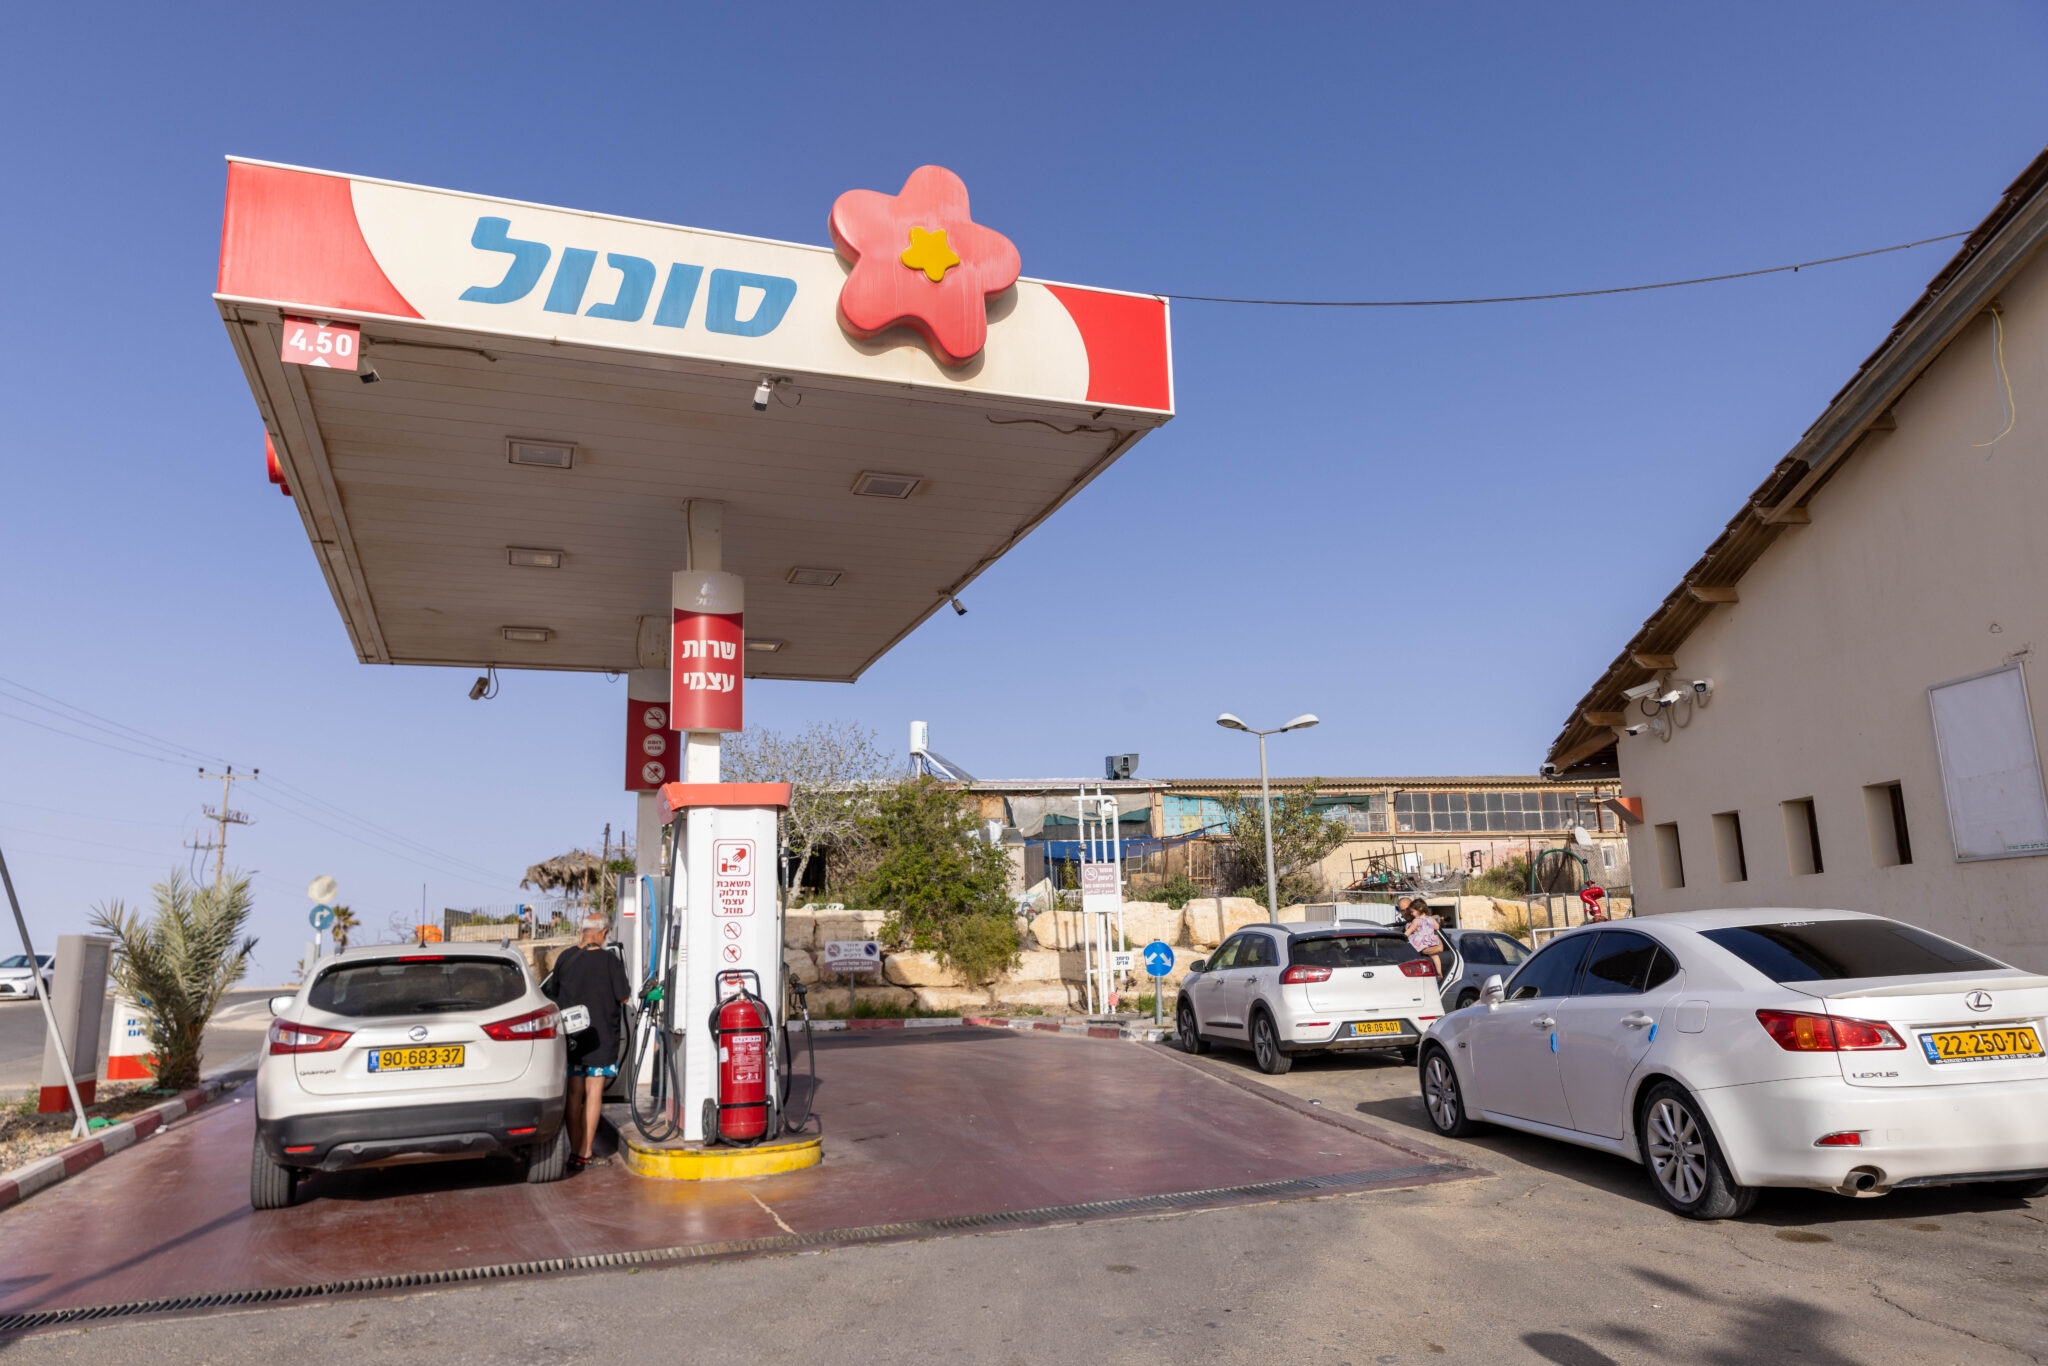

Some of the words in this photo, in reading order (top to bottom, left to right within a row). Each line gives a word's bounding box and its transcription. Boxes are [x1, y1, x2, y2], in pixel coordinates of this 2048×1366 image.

[458, 215, 798, 337] סונול
[289, 328, 353, 357] 4.50
[682, 640, 737, 660] שרות
[682, 672, 735, 693] עצמי
[716, 880, 751, 888] משאבת
[719, 889, 748, 898] תדלוק
[723, 906, 743, 914] מוזל
[1852, 1071, 1899, 1079] LEXUS
